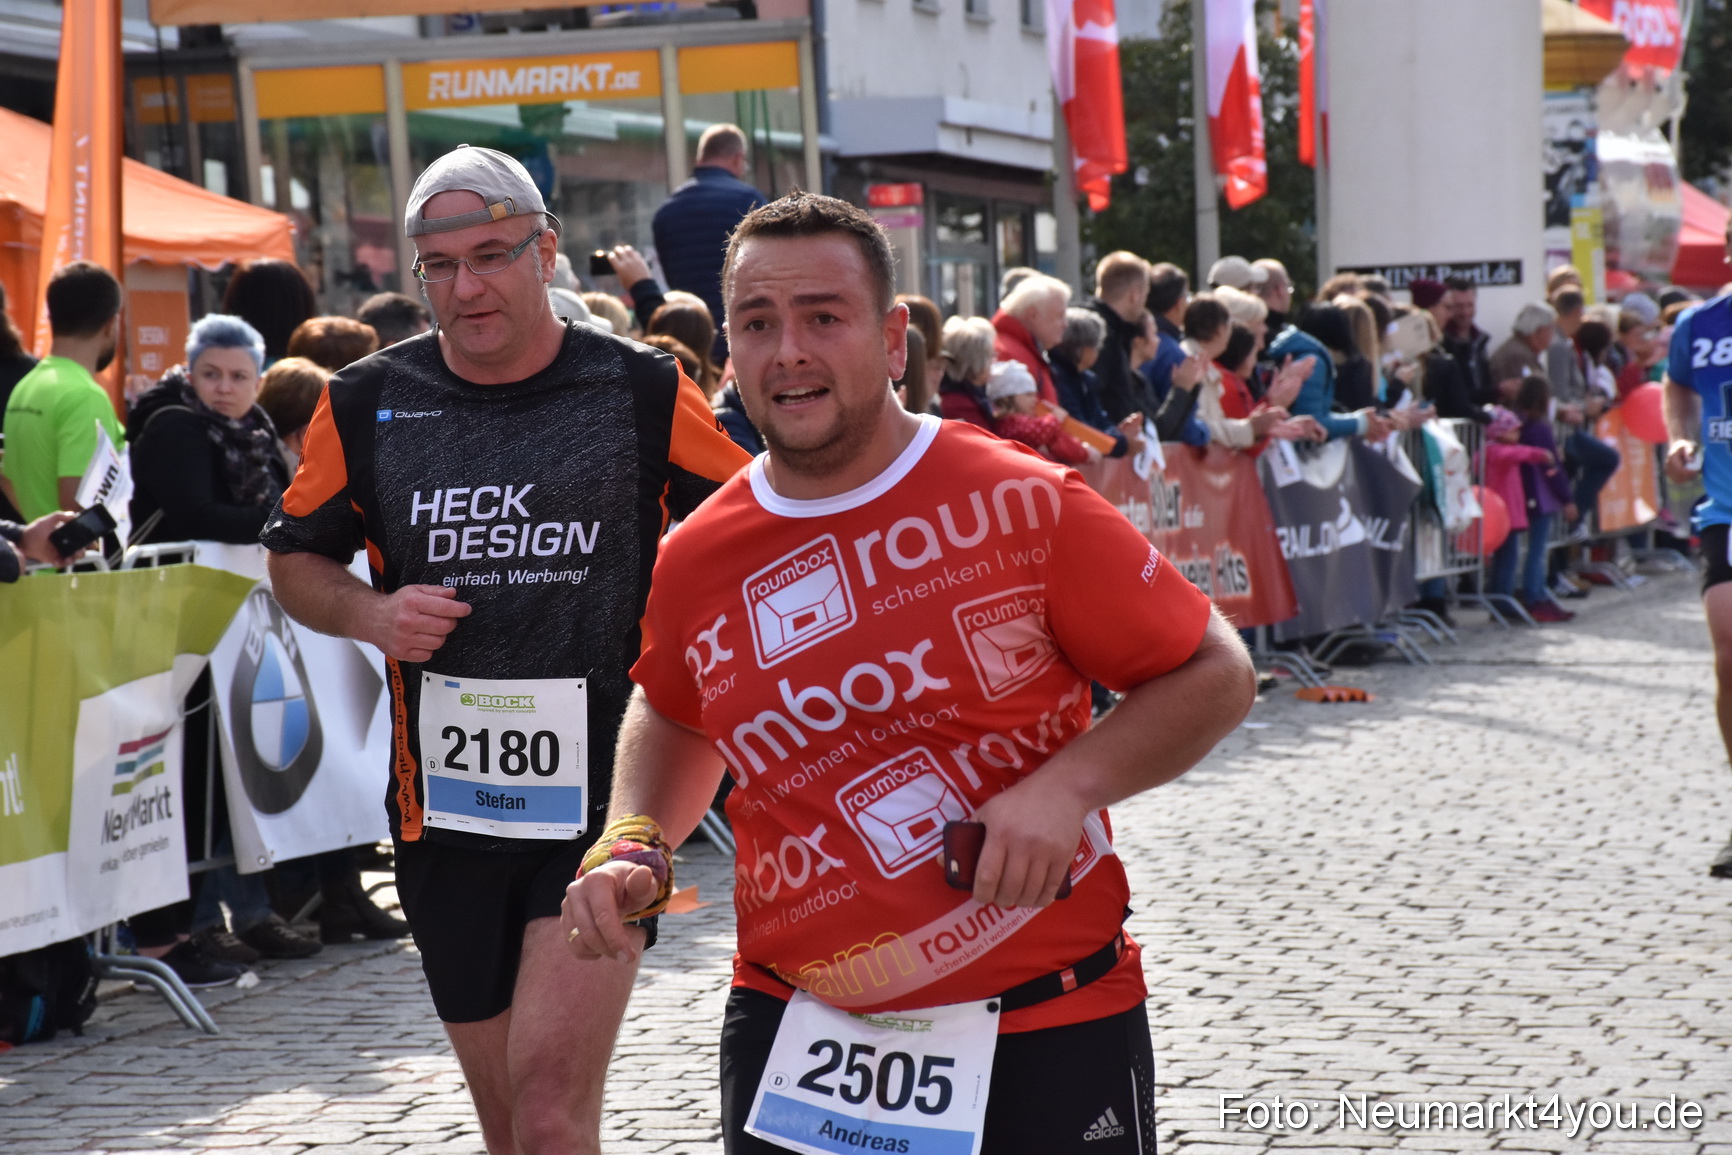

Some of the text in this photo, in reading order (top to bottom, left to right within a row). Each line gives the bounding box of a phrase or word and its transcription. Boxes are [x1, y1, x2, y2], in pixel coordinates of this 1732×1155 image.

[428, 62, 641, 100] RUNMARKT.DE
[410, 483, 536, 526] HECK
[427, 521, 600, 563] DESIGN
[442, 567, 589, 587] einfach Werbung!
[750, 546, 833, 601] raumbox
[872, 560, 992, 615] schenken
[477, 694, 536, 709] BOCK
[441, 725, 560, 777] 2180
[772, 741, 857, 798] wohnen
[871, 703, 961, 742] outdoor
[475, 790, 526, 810] Stefan
[846, 758, 932, 813] raumbox
[790, 880, 860, 923] outdoor
[918, 901, 1018, 964] raum
[934, 944, 984, 976] schenken
[989, 914, 1023, 943] wohnen
[796, 1039, 956, 1115] 2505
[818, 1119, 910, 1153] Andreas
[1083, 1125, 1125, 1141] adidas
